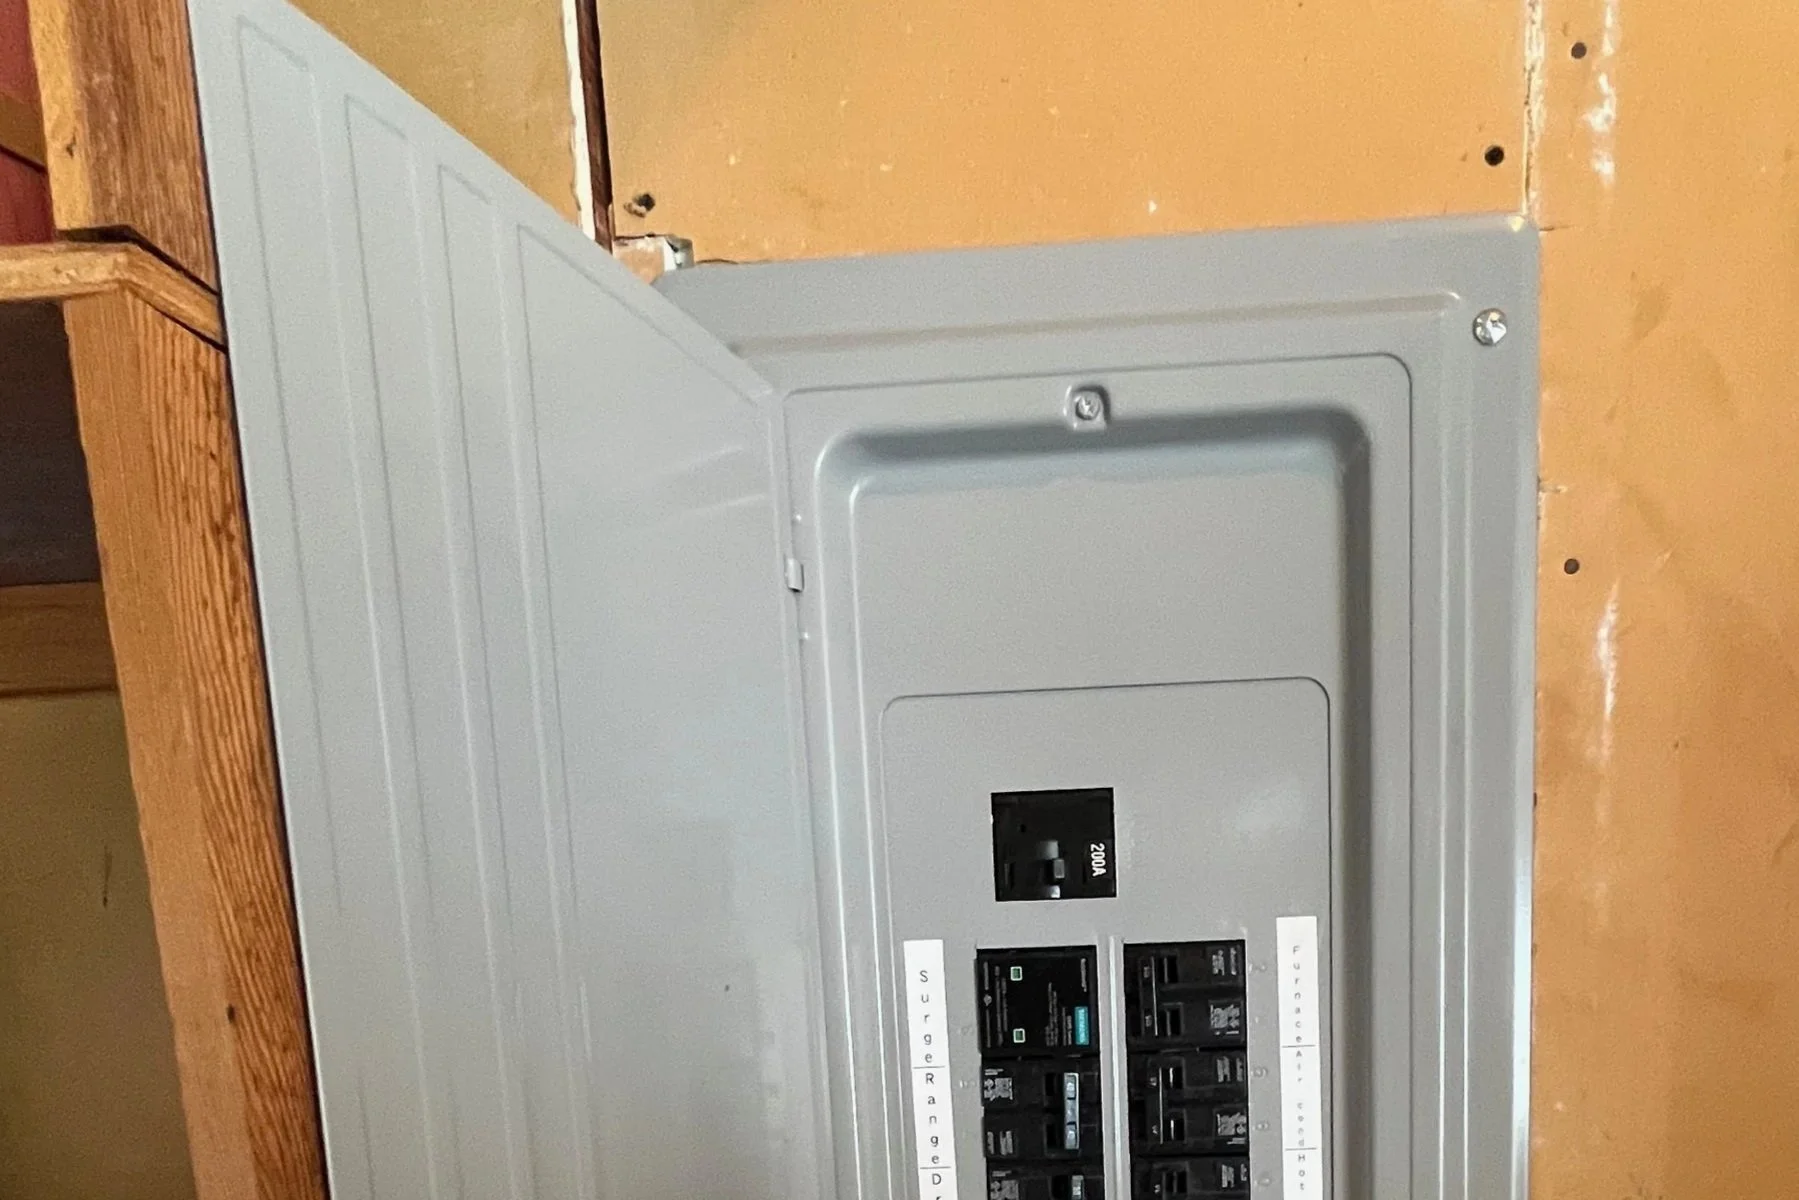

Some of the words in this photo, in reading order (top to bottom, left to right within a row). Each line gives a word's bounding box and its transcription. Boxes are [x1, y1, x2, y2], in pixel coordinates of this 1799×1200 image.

[1090, 842, 1107, 877] 200A
[919, 969, 933, 1064] Surge
[1293, 945, 1302, 1043] Furnace
[925, 1072, 940, 1165] Range
